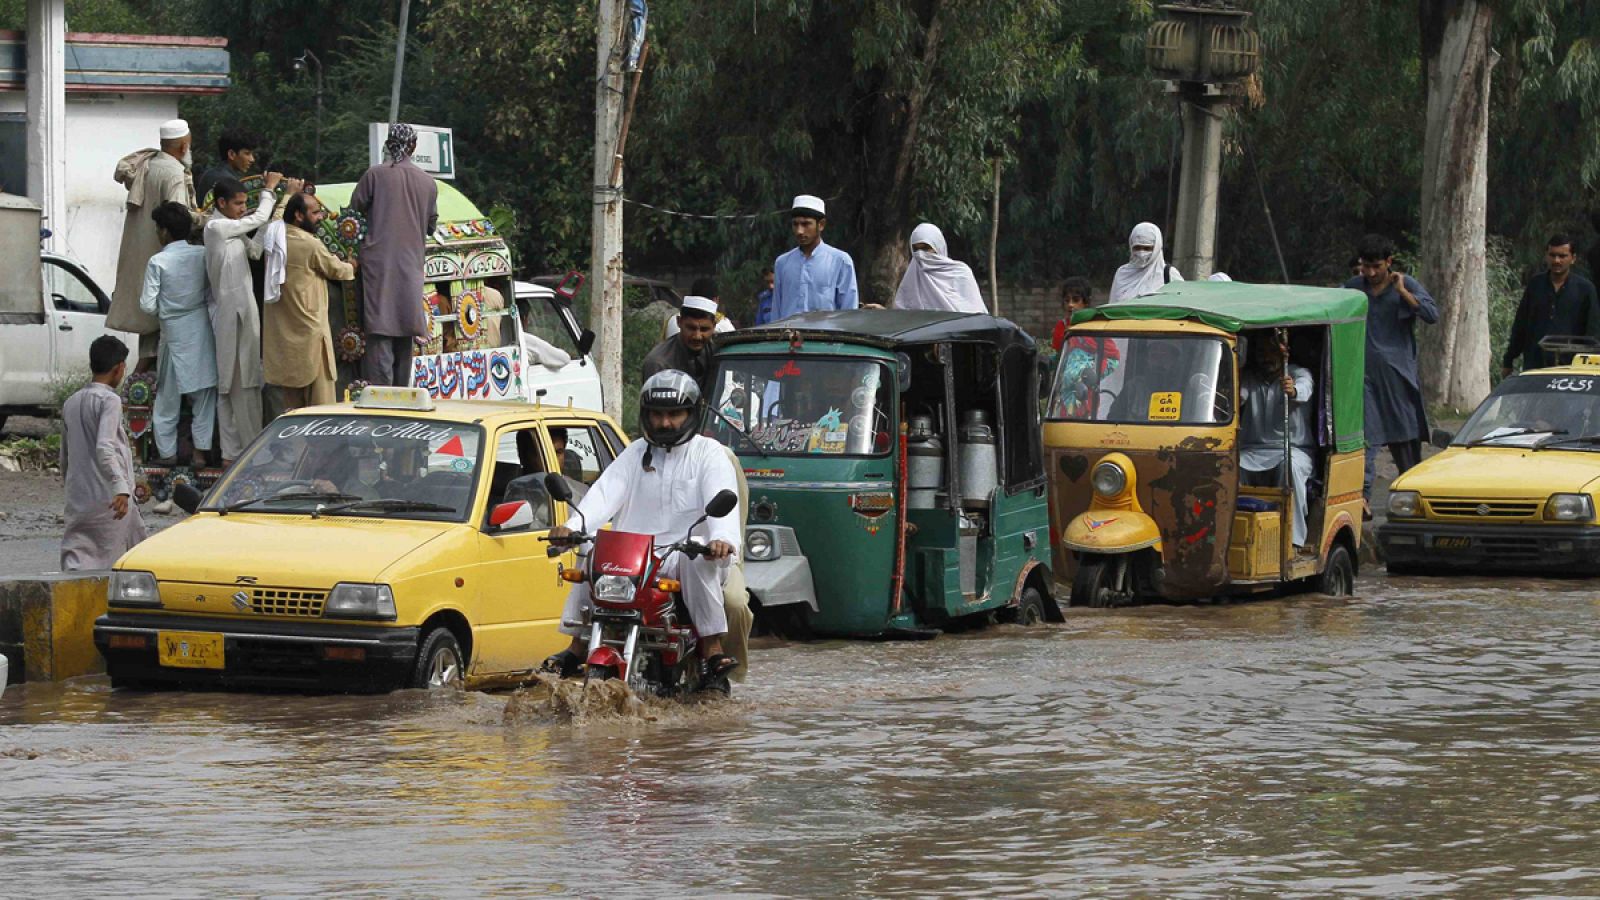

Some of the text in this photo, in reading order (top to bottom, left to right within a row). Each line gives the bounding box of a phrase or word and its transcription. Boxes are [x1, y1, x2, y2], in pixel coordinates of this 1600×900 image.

[427, 261, 449, 275] OVE
[279, 418, 453, 441] Masha Allah
